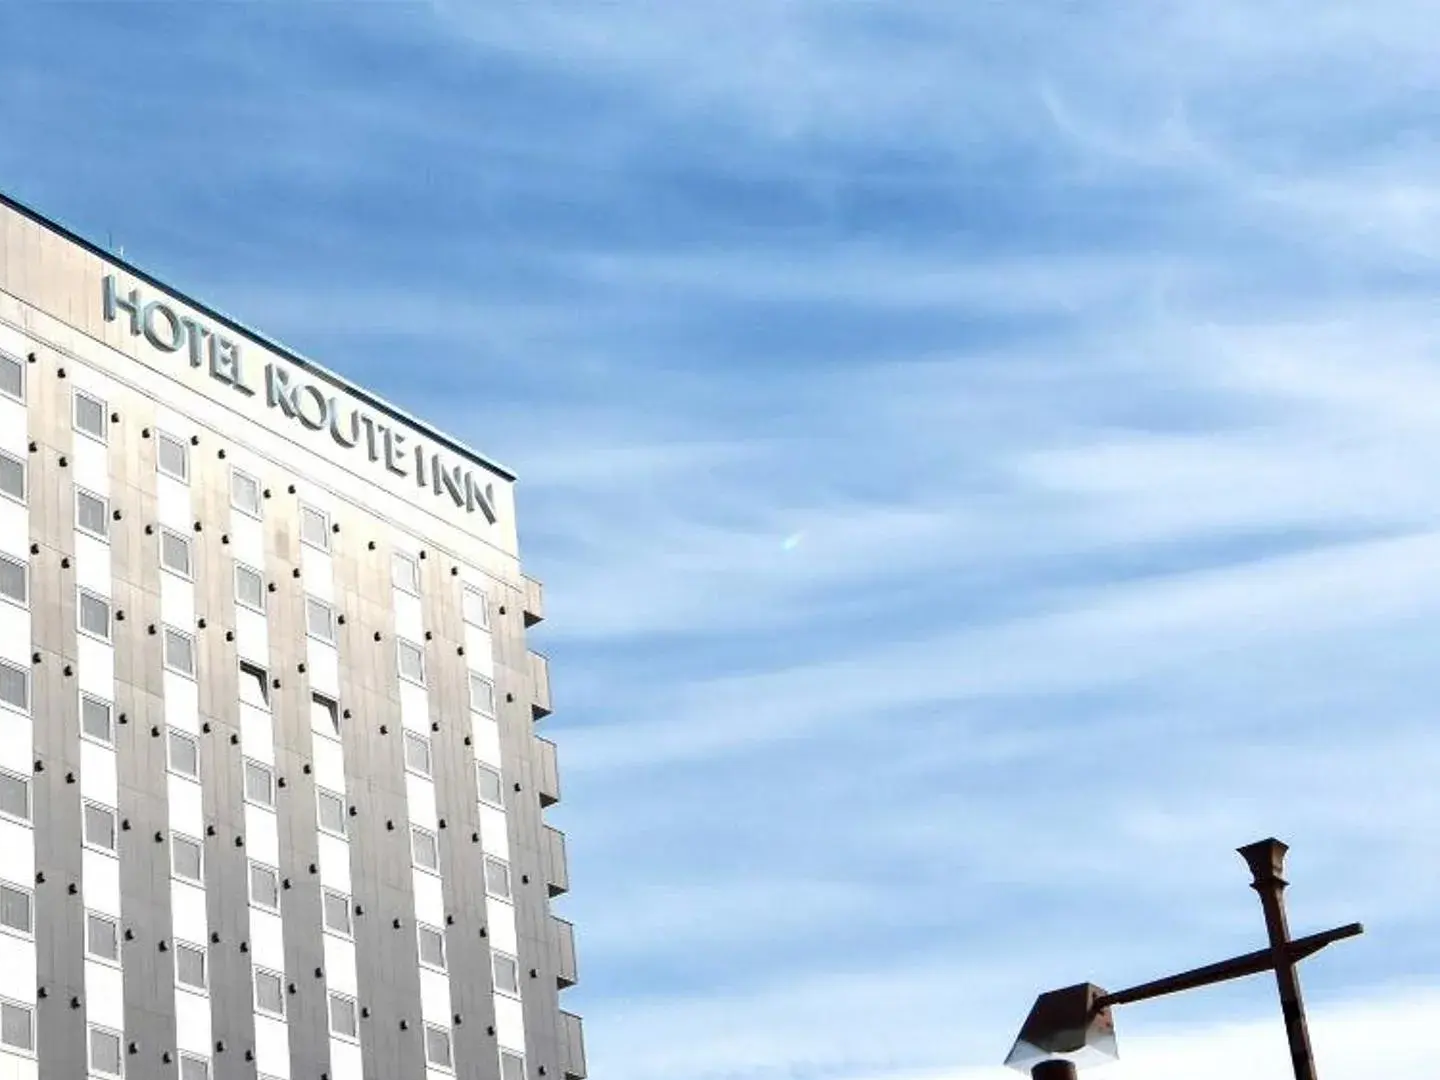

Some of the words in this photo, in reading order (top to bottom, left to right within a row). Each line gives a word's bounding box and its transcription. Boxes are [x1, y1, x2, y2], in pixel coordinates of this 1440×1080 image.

[103, 274, 256, 396] HOTEL
[265, 363, 407, 477] ROUTE
[415, 445, 497, 525] INN
